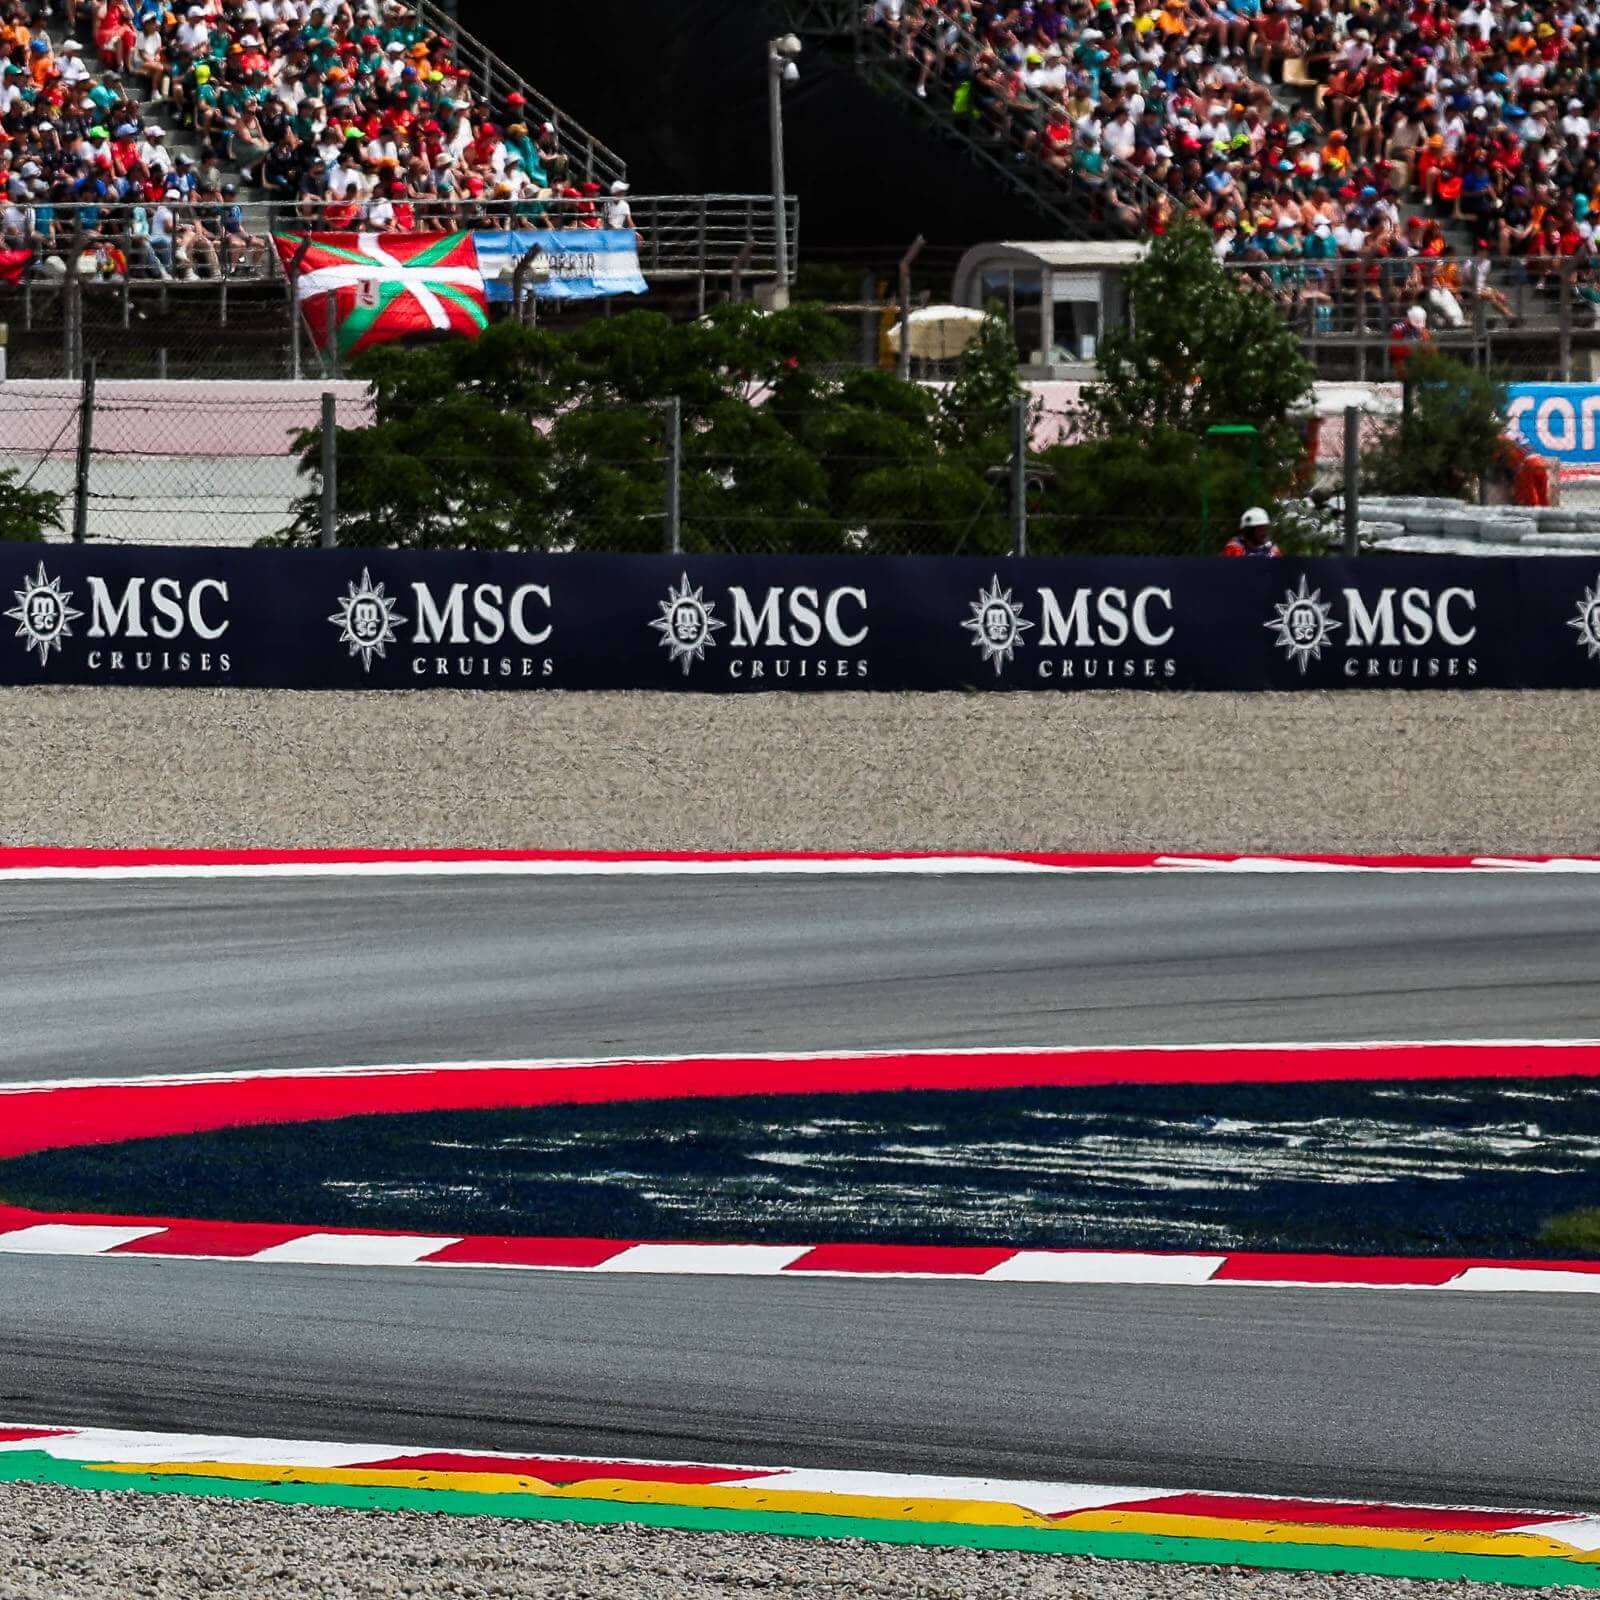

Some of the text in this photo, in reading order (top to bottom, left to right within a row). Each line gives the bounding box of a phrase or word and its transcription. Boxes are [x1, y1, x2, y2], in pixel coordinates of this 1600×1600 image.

[87, 577, 228, 639] MSC
[411, 583, 552, 644] MSC
[729, 587, 868, 646] MSC
[1037, 587, 1173, 646] MSC
[1343, 588, 1475, 645] MSC
[88, 652, 230, 671] CRUISES
[413, 658, 552, 675] CRUISES
[730, 660, 867, 678] CRUISES
[1039, 660, 1174, 677] CRUISES
[1345, 659, 1476, 676] CRUISES
